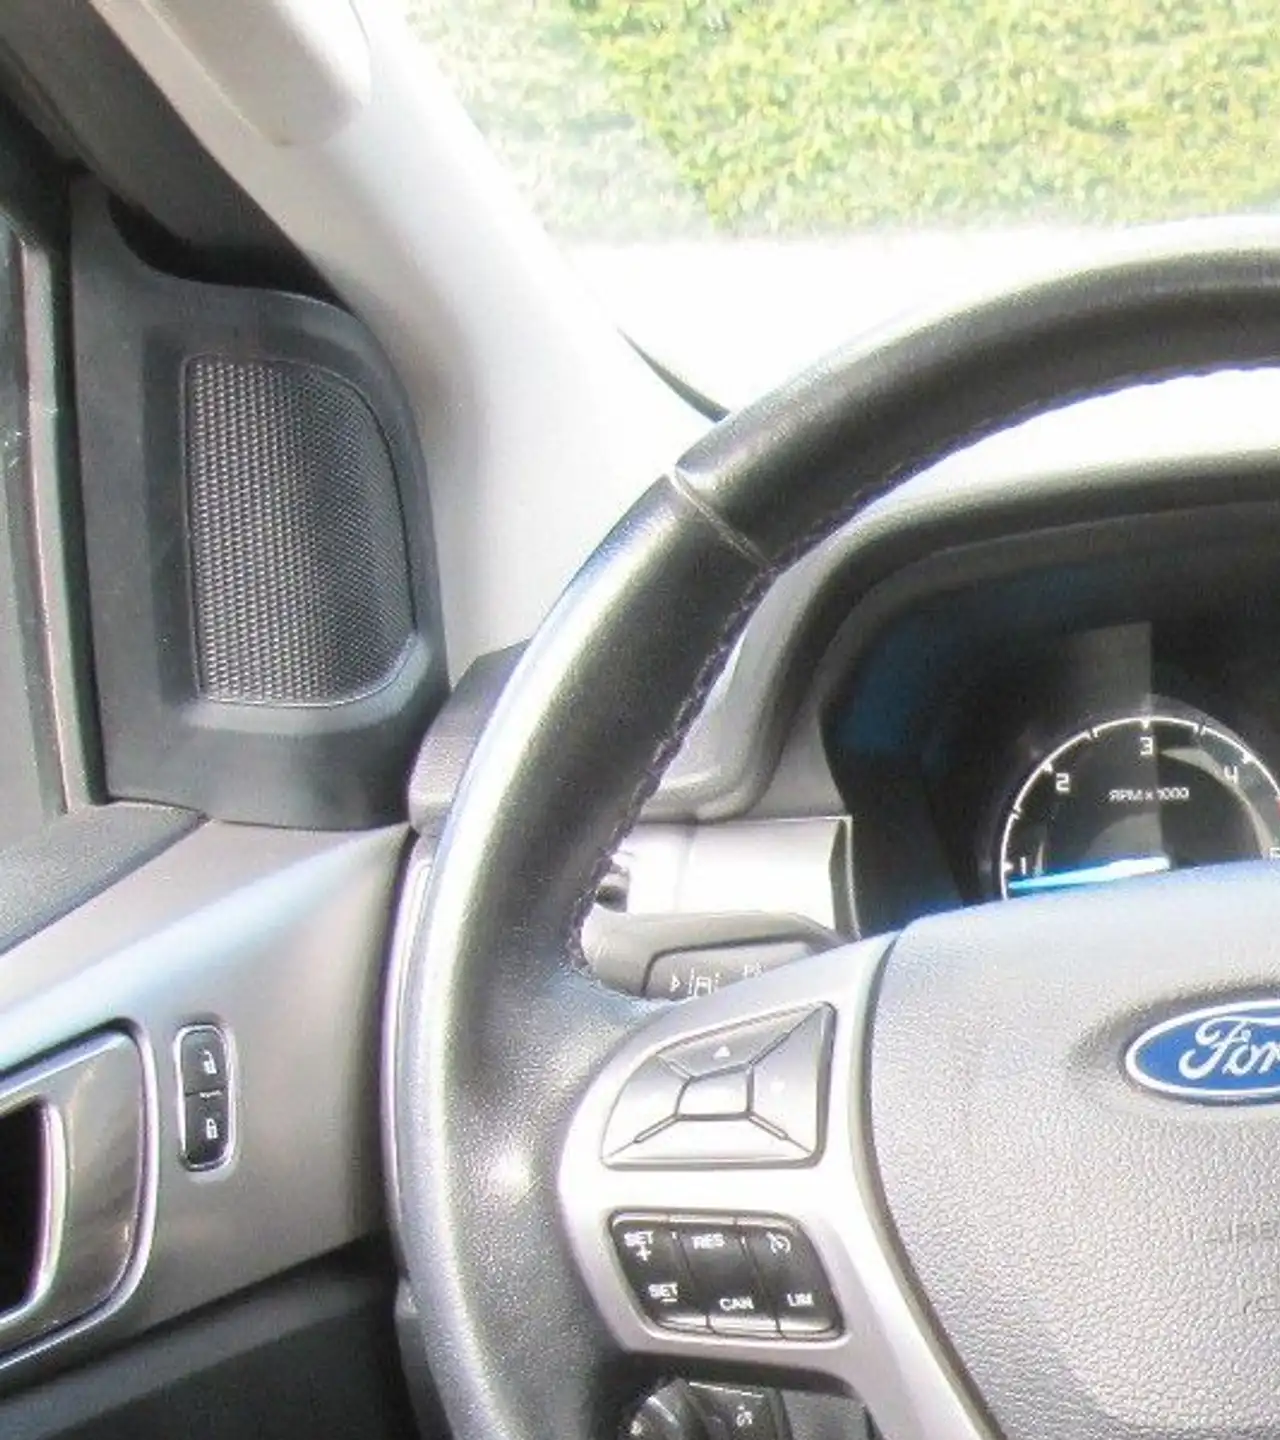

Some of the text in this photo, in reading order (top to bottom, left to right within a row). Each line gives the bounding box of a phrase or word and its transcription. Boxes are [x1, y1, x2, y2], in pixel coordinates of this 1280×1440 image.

[1140, 737, 1154, 756] 3
[1055, 773, 1070, 793] 2
[1224, 766, 1239, 784] 4
[1157, 787, 1190, 800] 1000
[624, 1231, 654, 1247] SET
[691, 1233, 725, 1249] RES
[649, 1283, 679, 1299] SET
[718, 1296, 755, 1311] CAN
